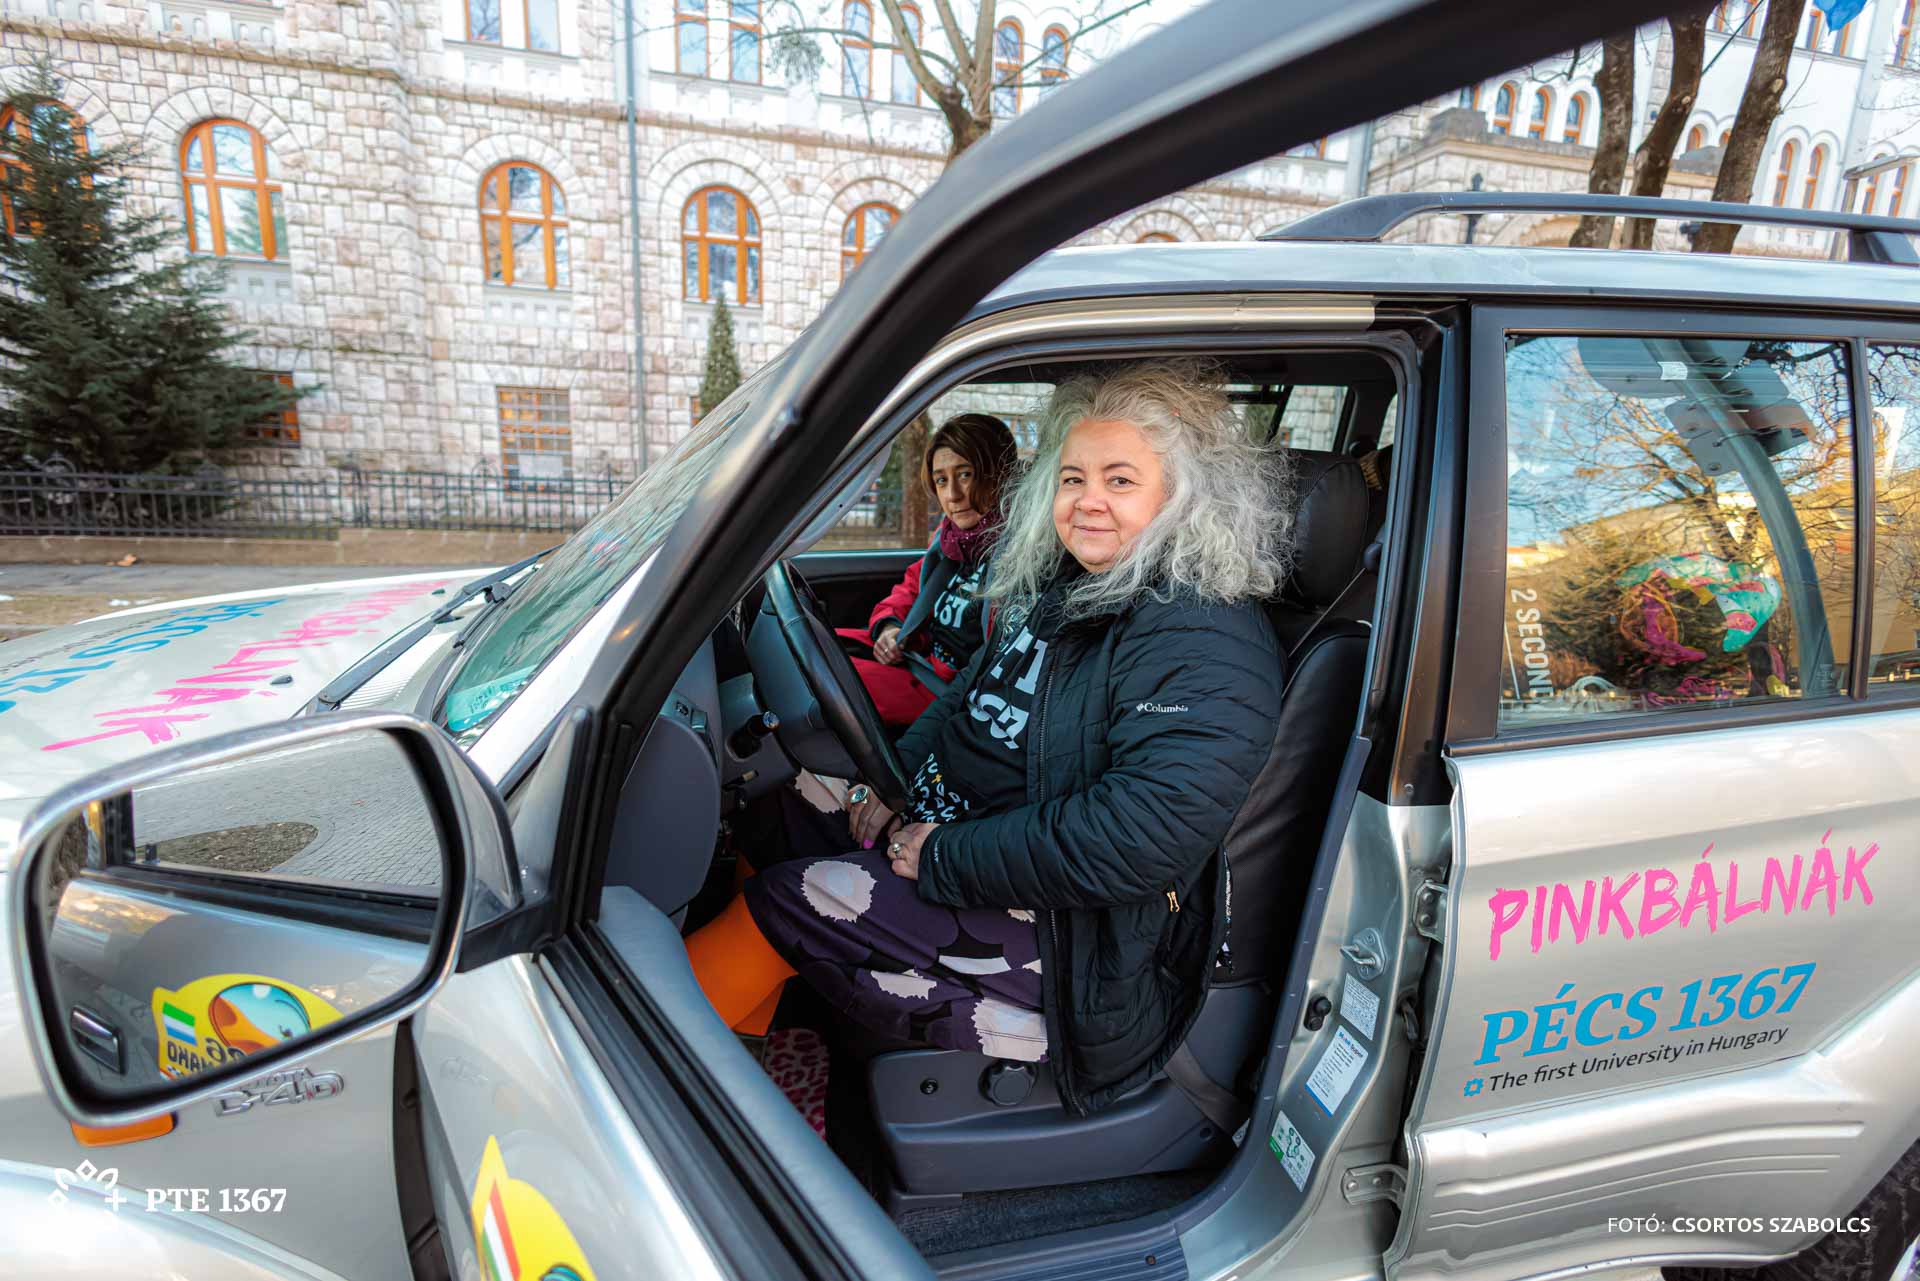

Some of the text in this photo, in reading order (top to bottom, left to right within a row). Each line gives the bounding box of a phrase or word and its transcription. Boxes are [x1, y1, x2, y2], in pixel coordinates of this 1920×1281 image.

[1510, 588, 1538, 603] 2
[1144, 702, 1189, 713] Columbia
[1488, 827, 1881, 961] PINKBÁLNÁK
[1474, 963, 1817, 1066] PÉCS 1367
[1489, 1026, 1789, 1092] The first University in Hungary
